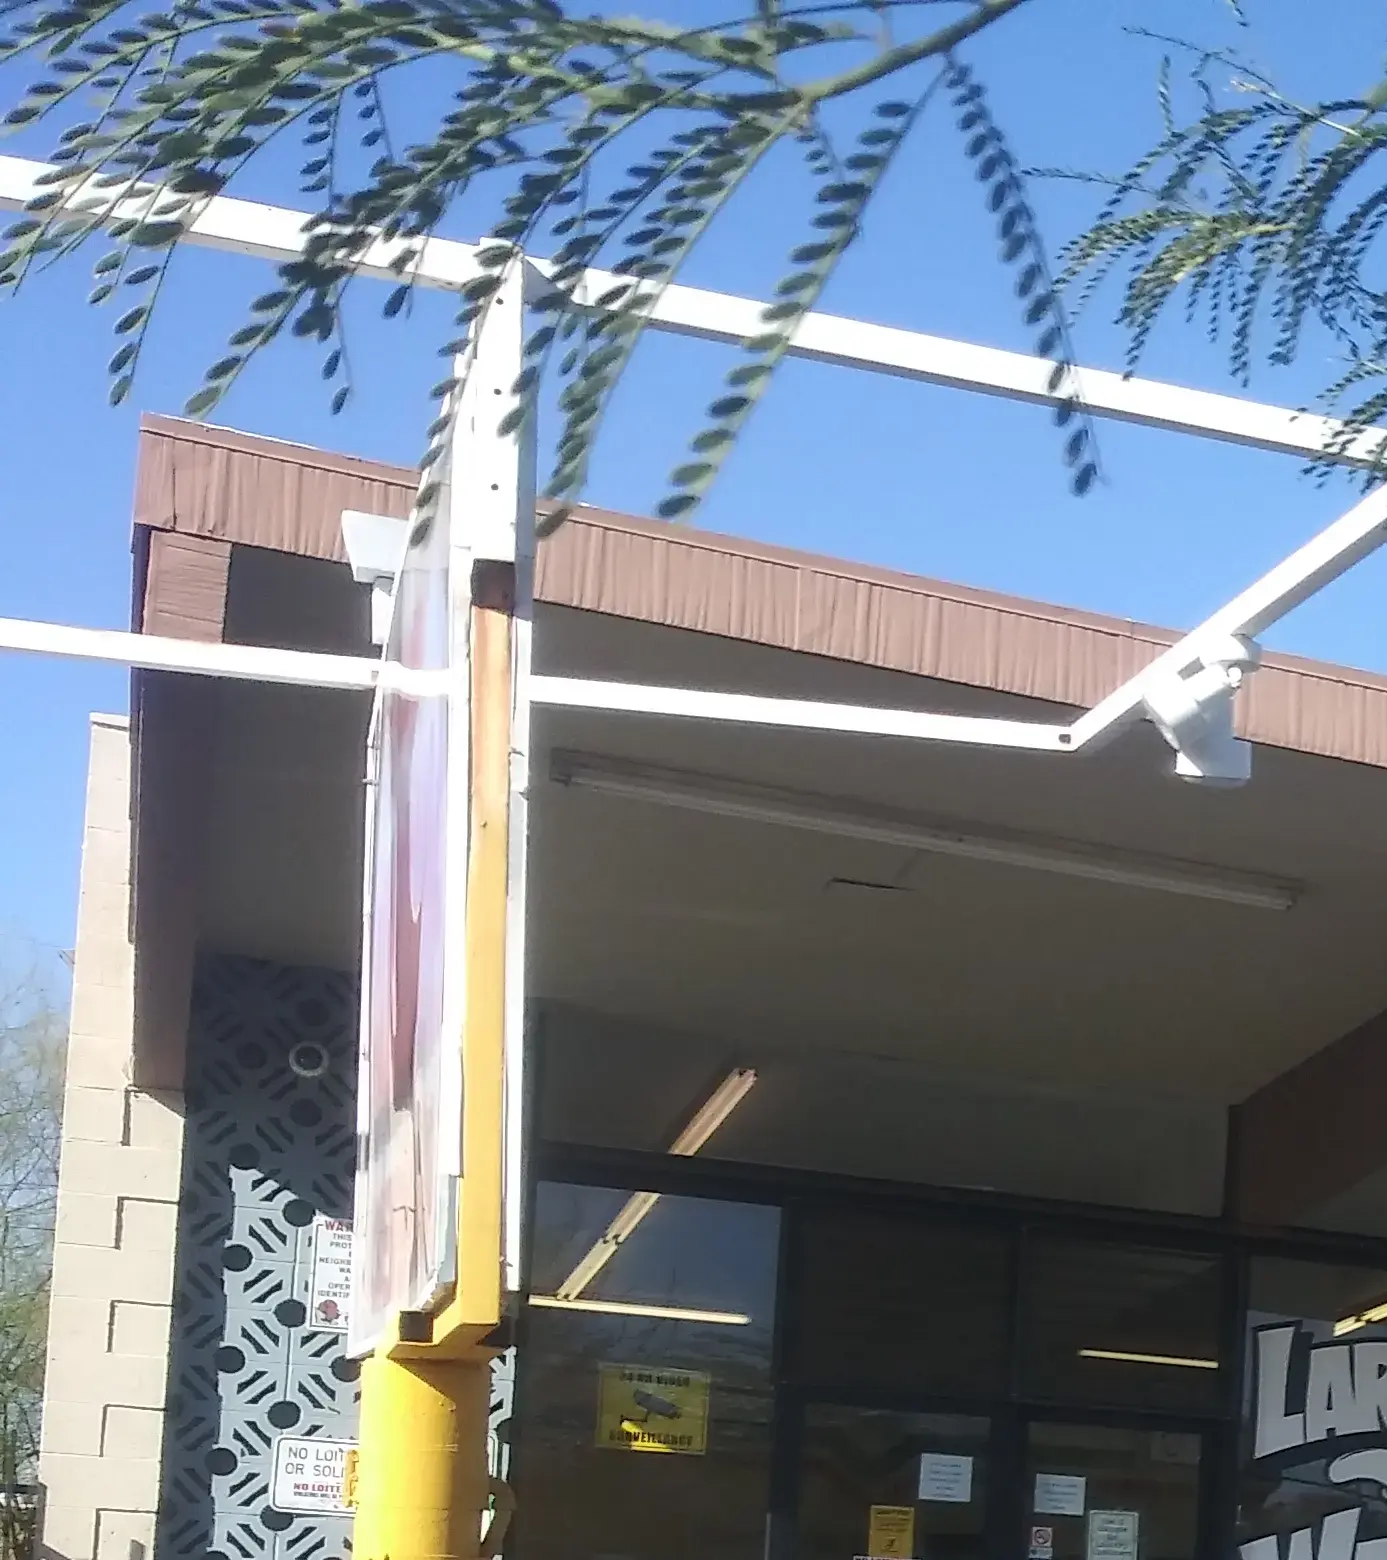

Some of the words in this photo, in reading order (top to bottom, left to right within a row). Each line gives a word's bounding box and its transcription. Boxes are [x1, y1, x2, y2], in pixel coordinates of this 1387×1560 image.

[288, 1447, 308, 1460] NO
[285, 1462, 304, 1475] OR
[294, 1482, 309, 1491] NO
